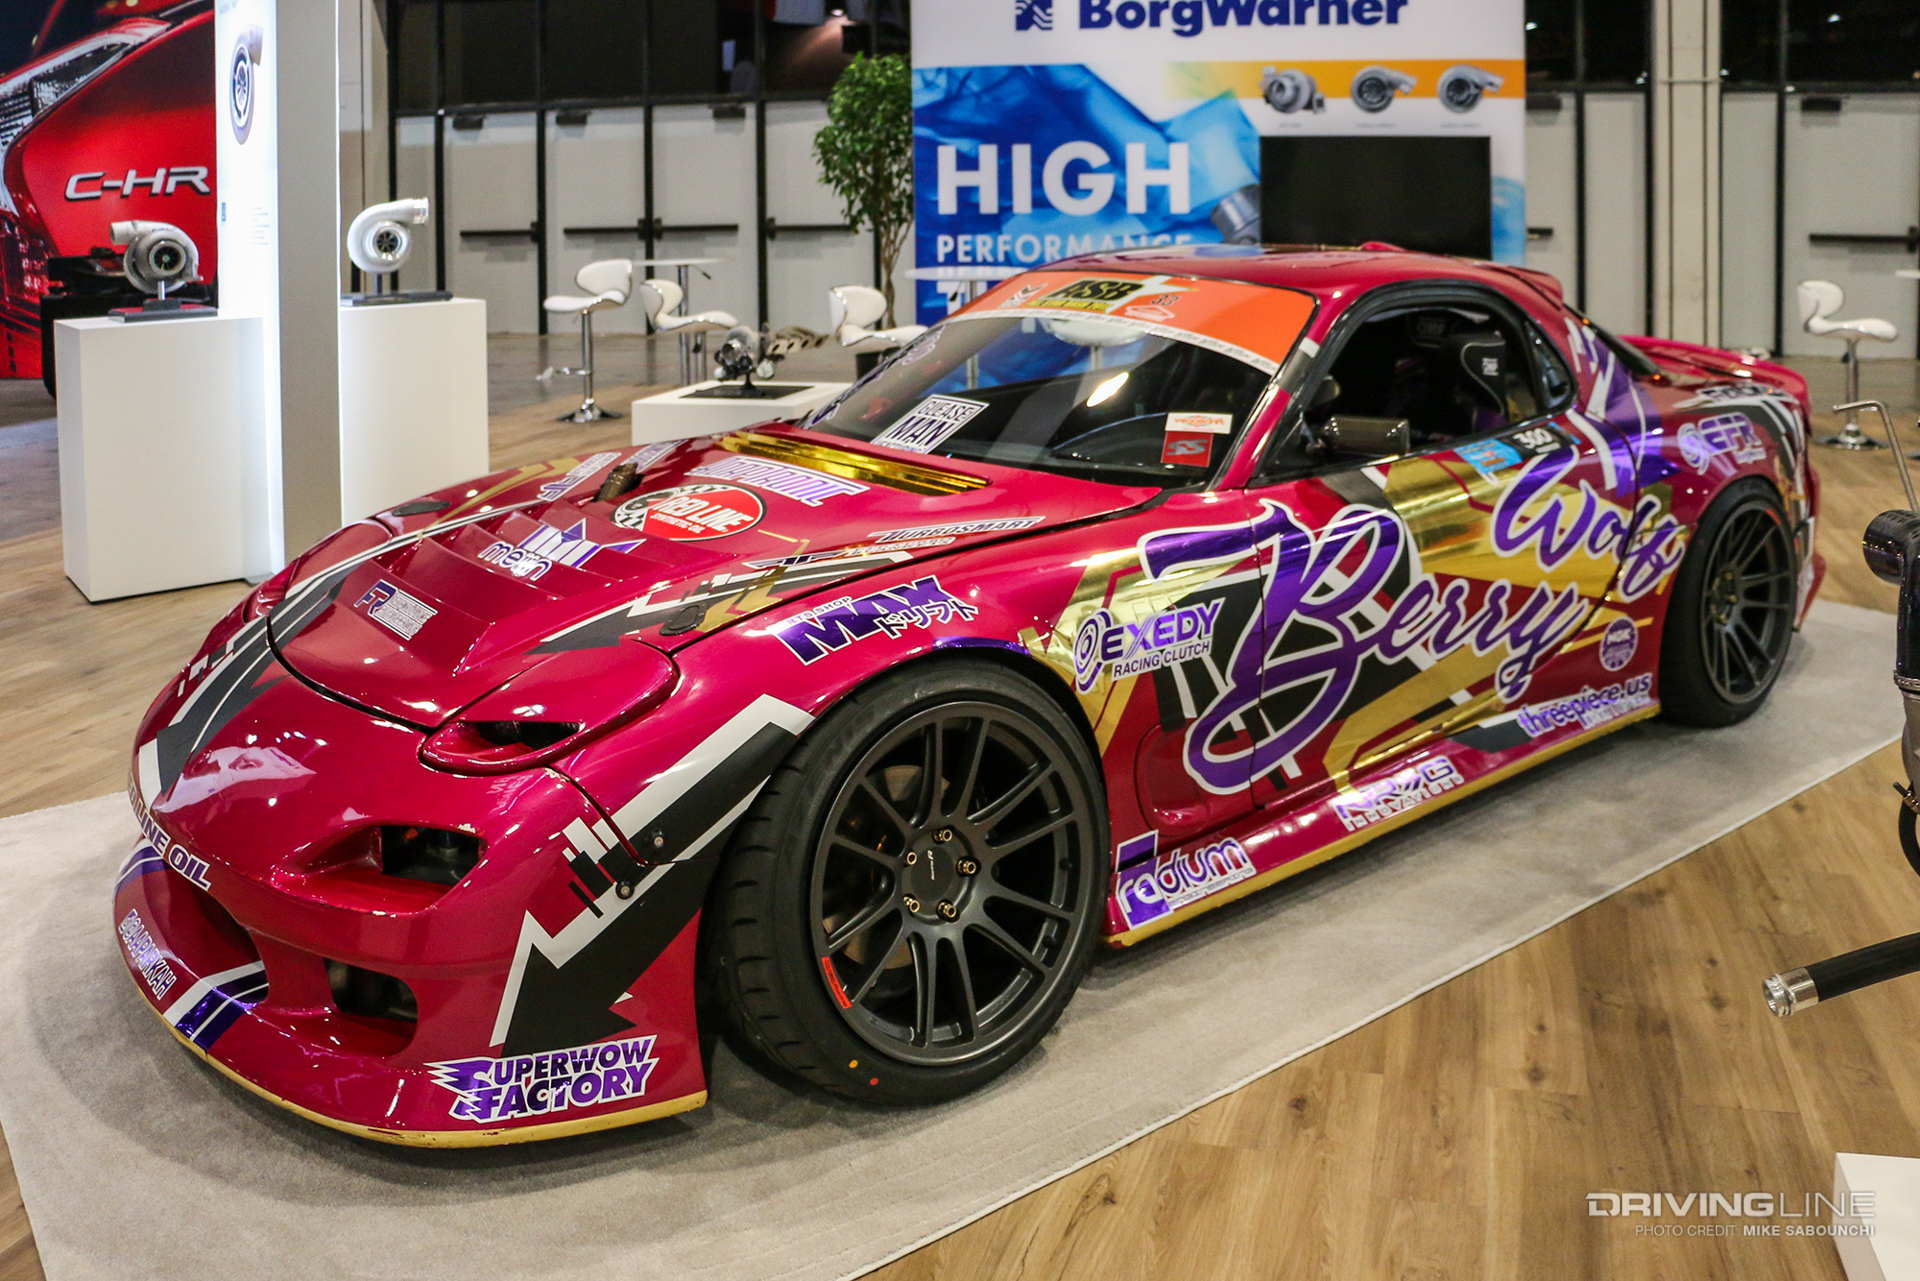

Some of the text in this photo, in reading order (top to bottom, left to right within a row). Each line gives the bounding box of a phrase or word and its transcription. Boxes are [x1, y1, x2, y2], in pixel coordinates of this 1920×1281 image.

[1079, 0, 1405, 37] BorgWarner
[65, 166, 211, 201] C-HR
[937, 141, 1191, 216] HIGH
[884, 415, 956, 446] MAN
[652, 496, 755, 532] RED LINE
[867, 515, 1046, 544] TURBOSMART
[1489, 444, 1687, 604] Wolf
[477, 540, 552, 582] men
[777, 575, 952, 666] MAX
[786, 597, 852, 626] RTS SHOP
[873, 598, 979, 640] ドリフト
[1100, 598, 1227, 663] EXEDY
[1112, 641, 1211, 680] RACING CLUTCH
[1137, 498, 1589, 796] Berry
[1517, 673, 1653, 737] threepiece.us
[1344, 772, 1465, 832] INNOVATIONS
[137, 798, 171, 858] LINE
[168, 843, 212, 892] OIL
[1117, 837, 1252, 914] radium
[424, 1036, 656, 1092] SUPERWOW
[449, 1059, 660, 1124] FACTORY
